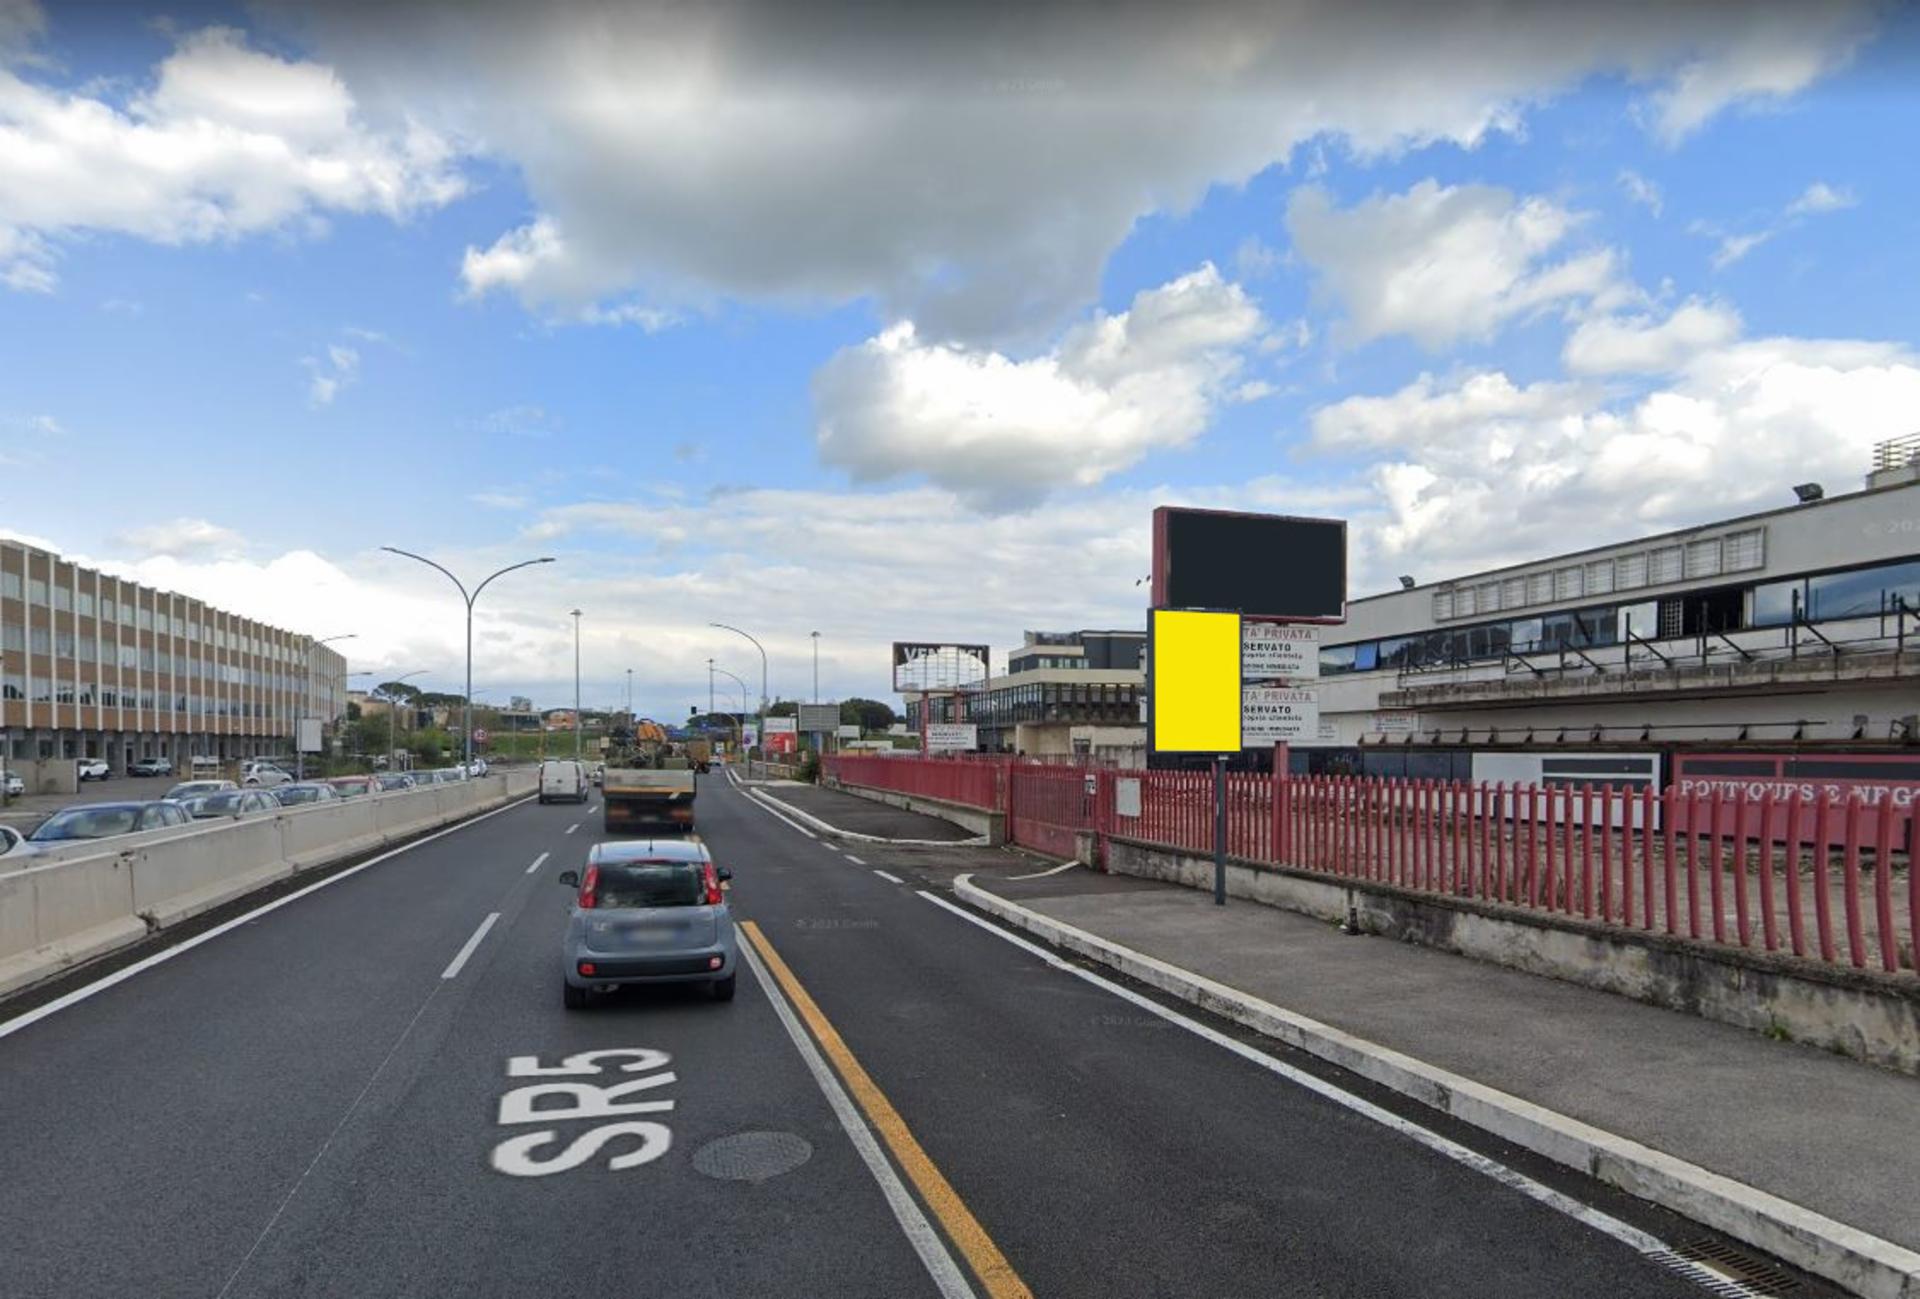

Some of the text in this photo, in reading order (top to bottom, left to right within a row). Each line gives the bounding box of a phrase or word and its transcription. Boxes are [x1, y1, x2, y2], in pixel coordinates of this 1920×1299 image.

[1264, 627, 1312, 640] PRIVATA
[1264, 690, 1312, 702] PRIVATA
[1851, 785, 1920, 806] NEG
[492, 1047, 678, 1177] SR5
